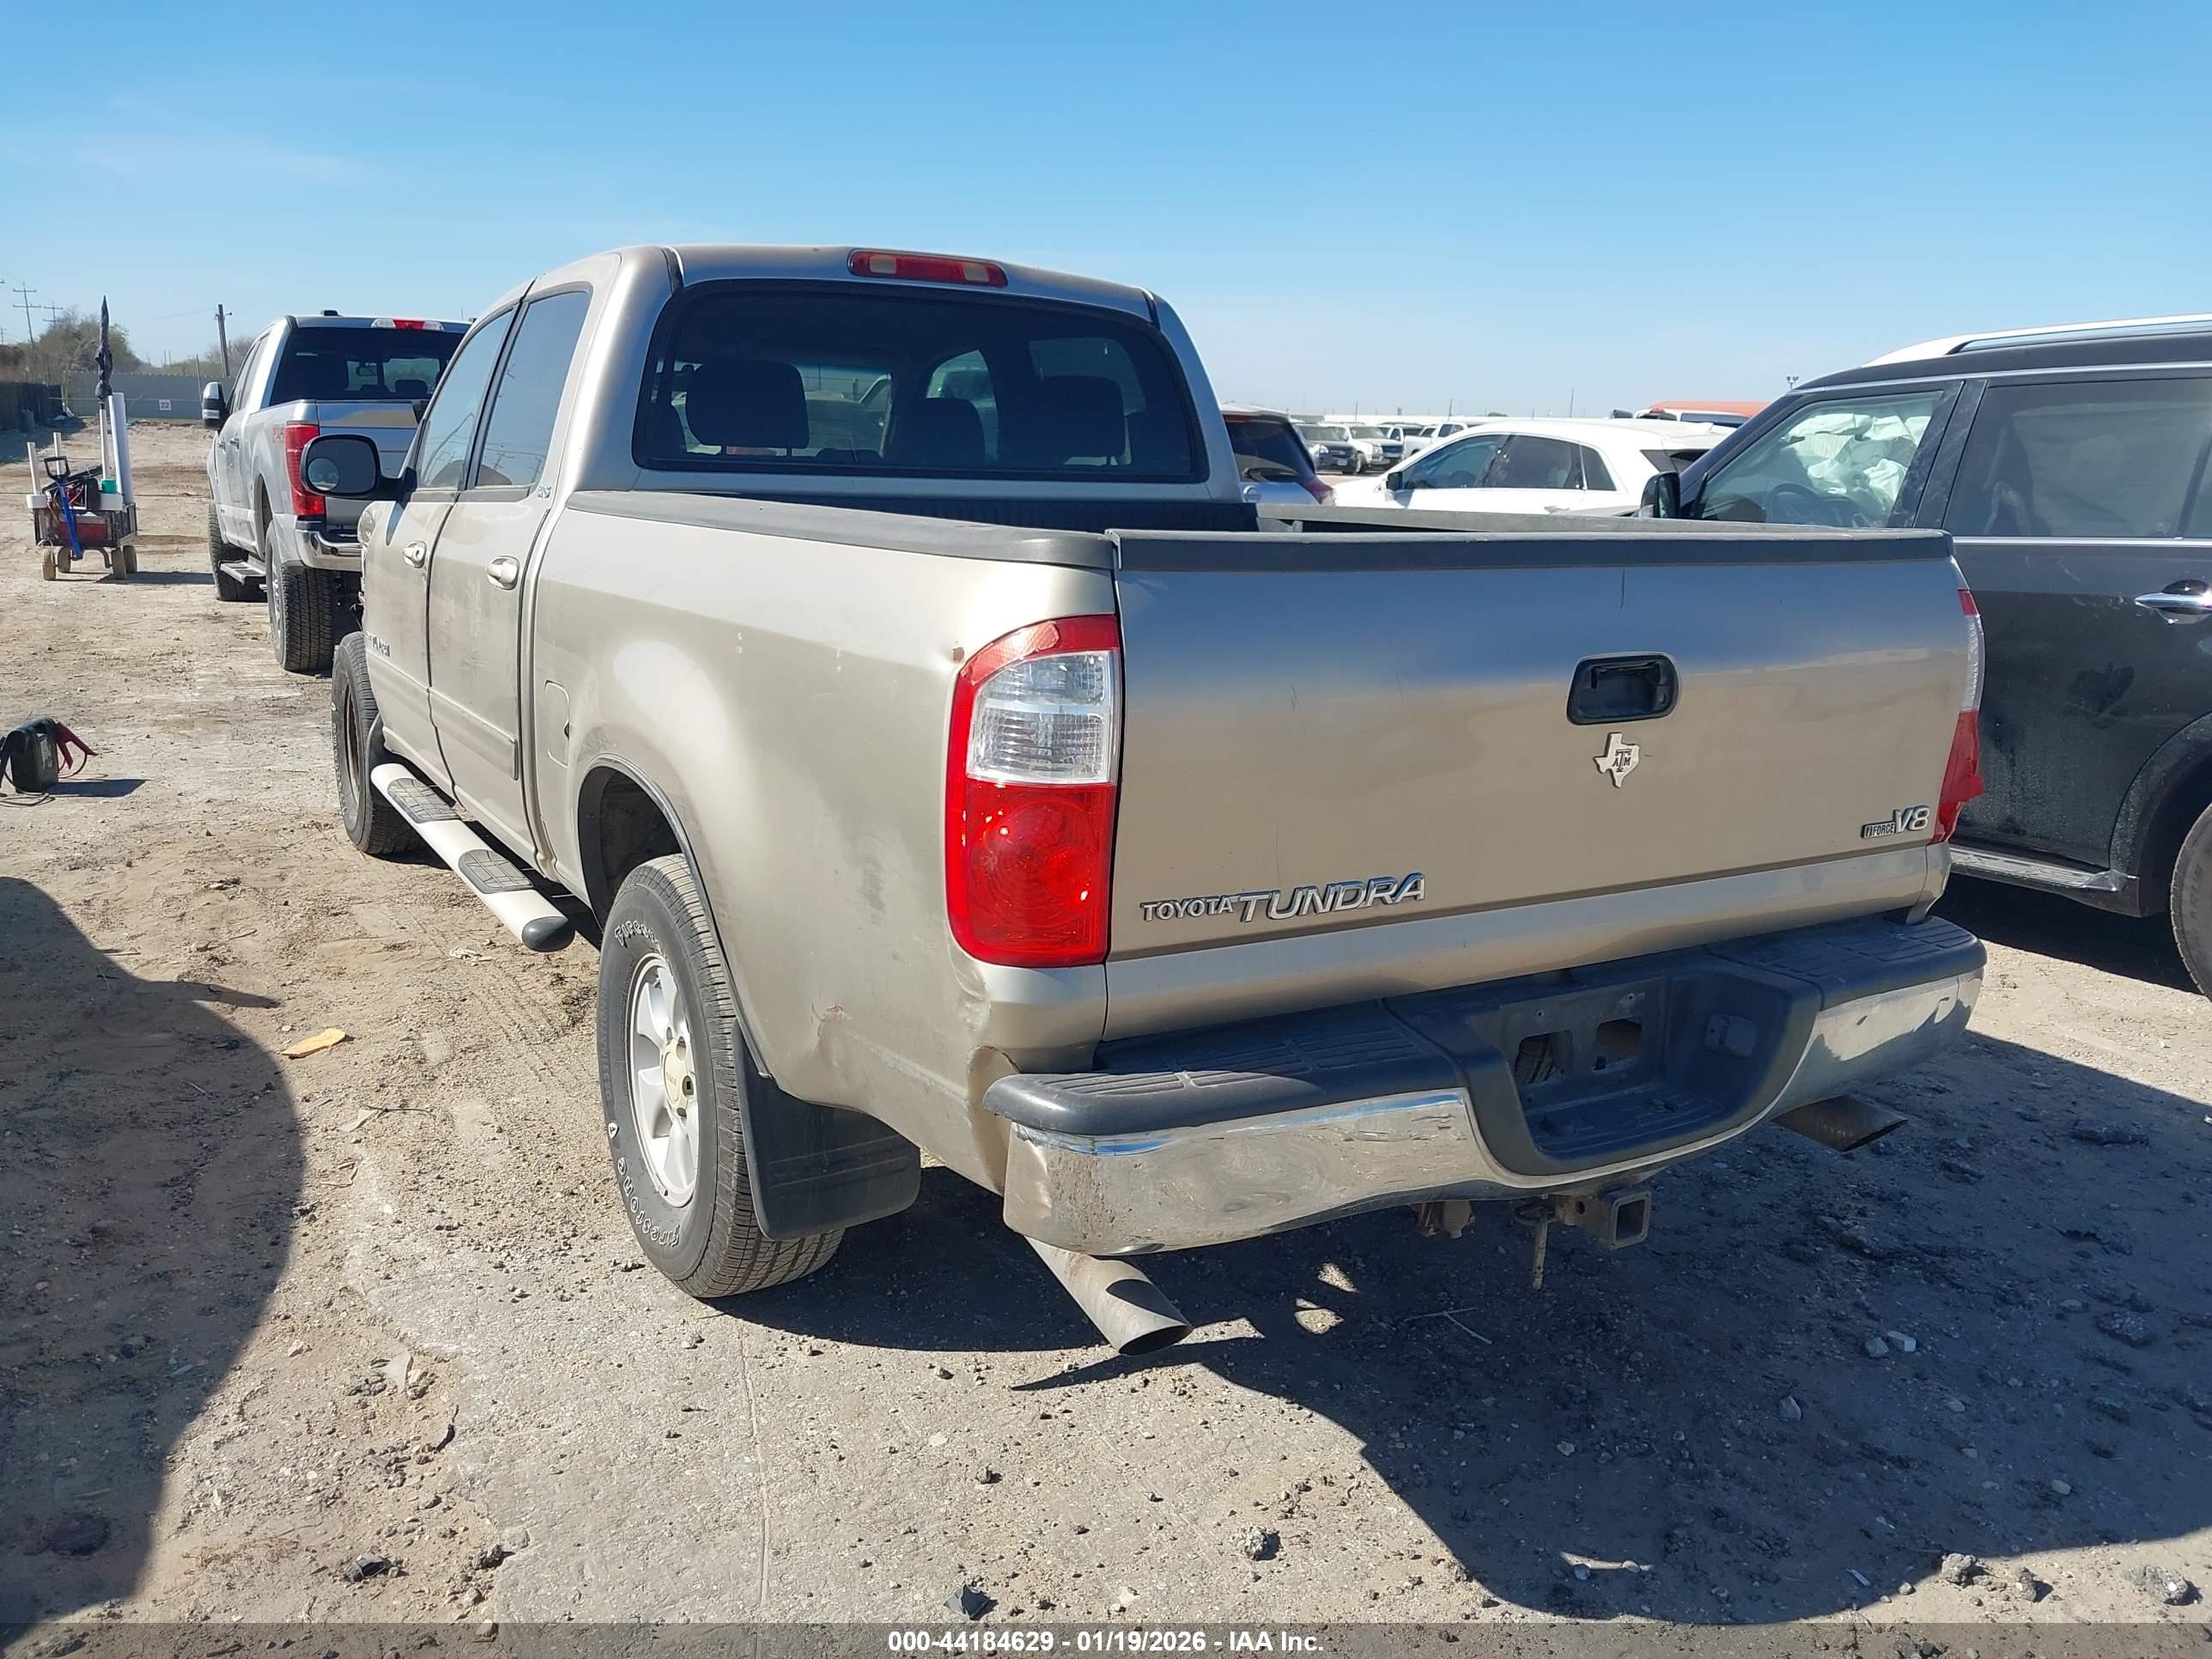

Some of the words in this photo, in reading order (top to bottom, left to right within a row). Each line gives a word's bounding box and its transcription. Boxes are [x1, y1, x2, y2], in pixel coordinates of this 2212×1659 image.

[1893, 805, 1930, 834] V8
[1141, 896, 1235, 921] TOYOTA
[1237, 872, 1425, 923] TUNDRA
